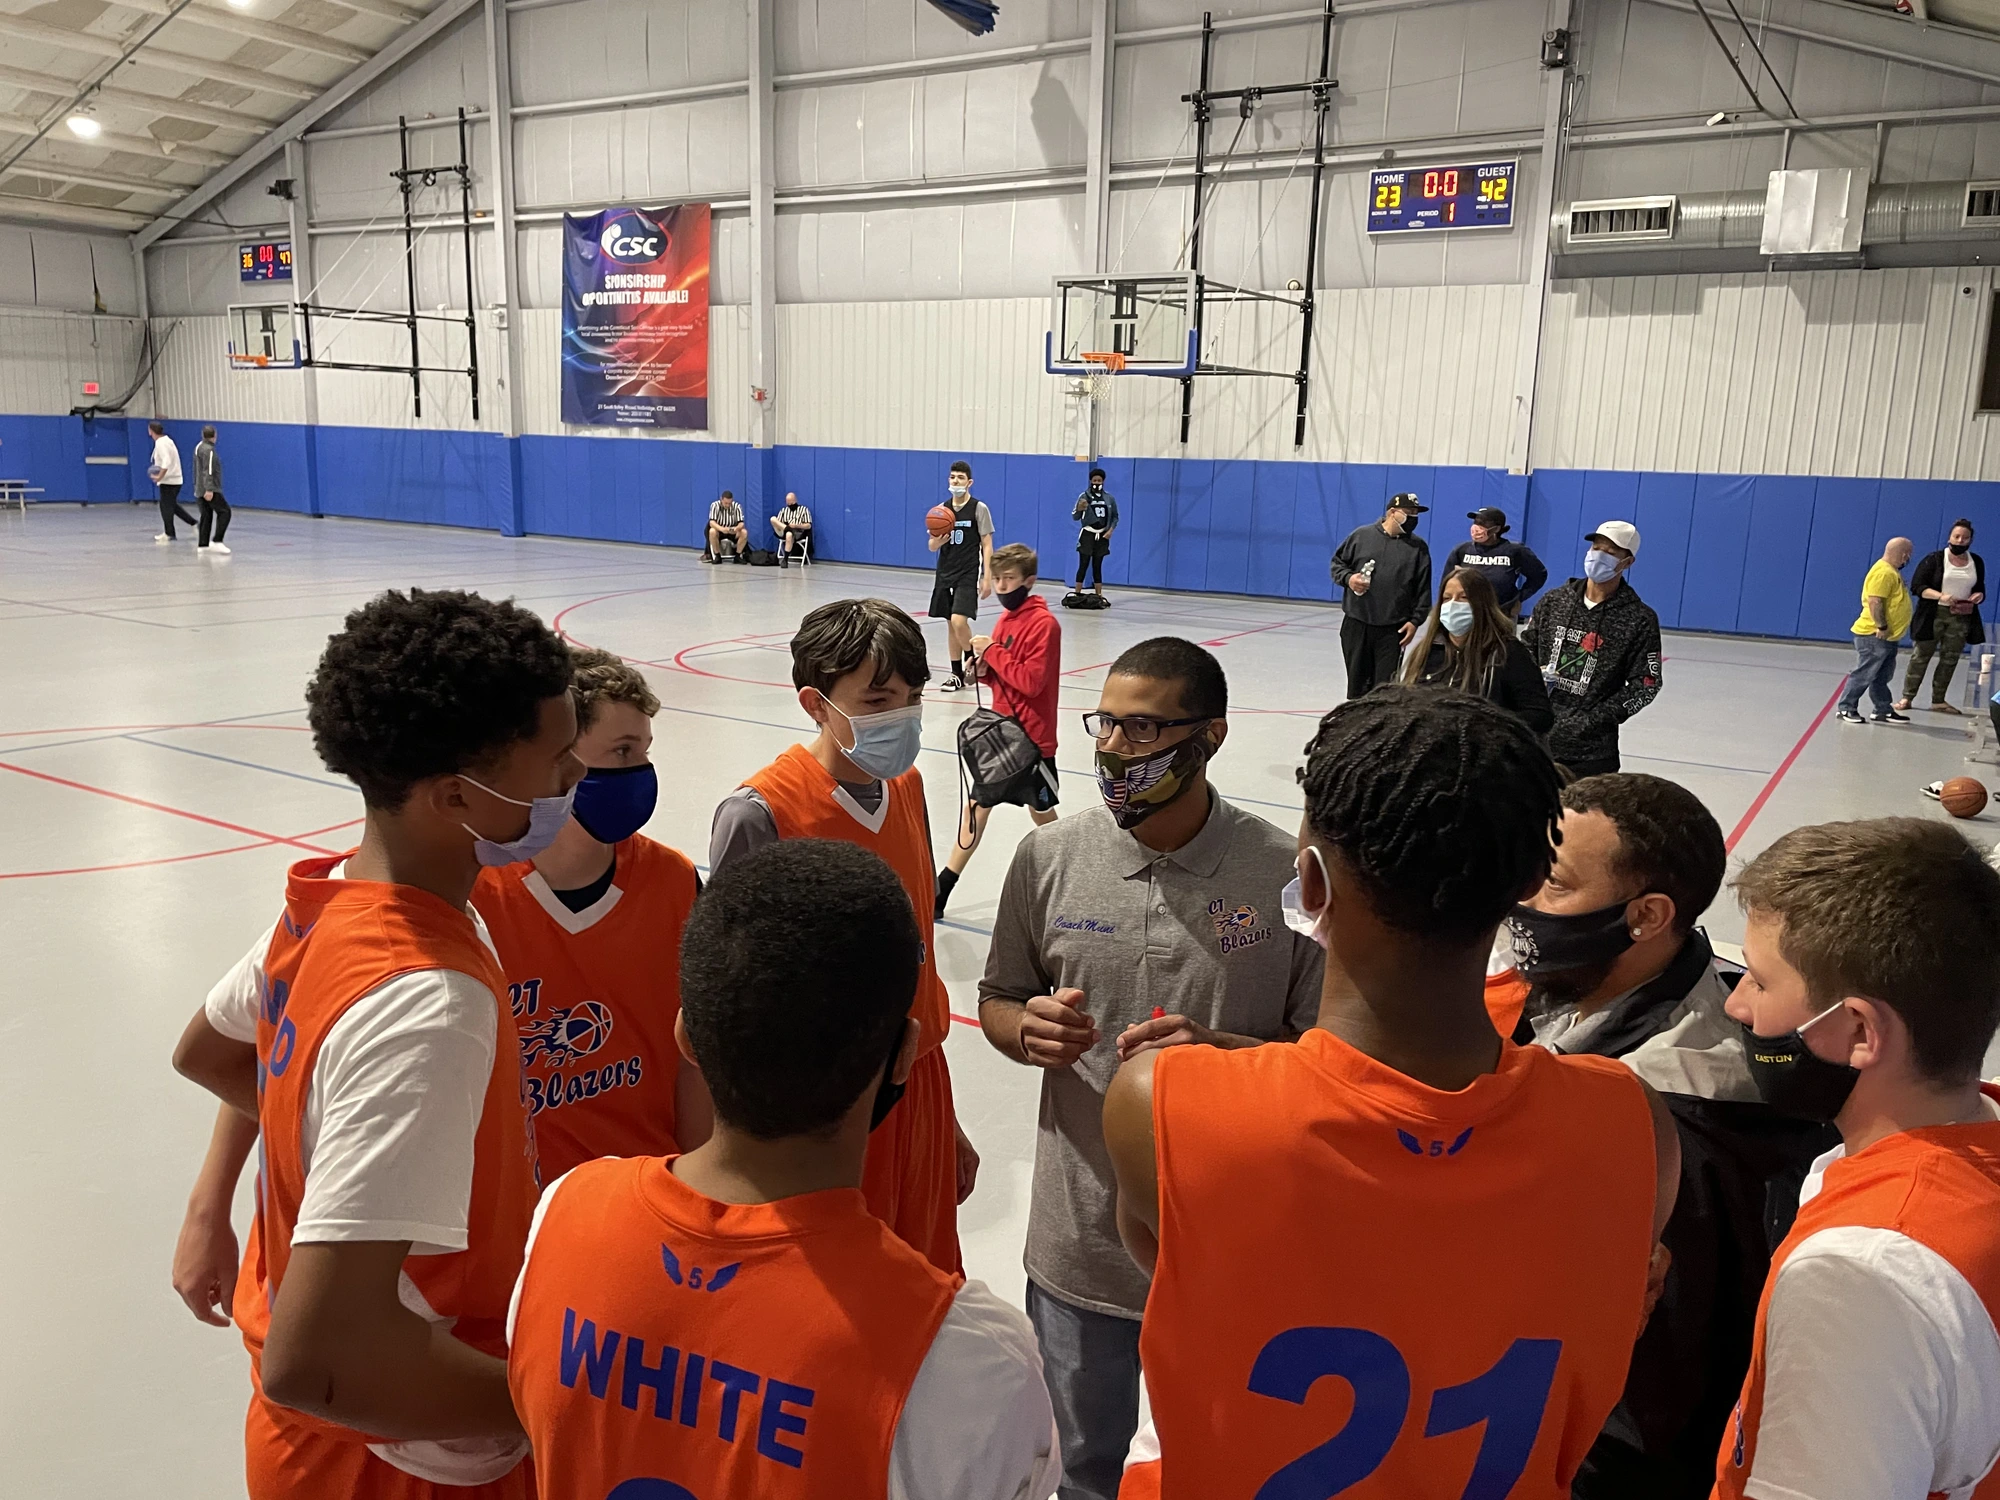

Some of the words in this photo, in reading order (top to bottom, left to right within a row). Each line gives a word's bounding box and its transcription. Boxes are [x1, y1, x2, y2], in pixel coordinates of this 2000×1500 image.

[1374, 174, 1405, 185] HOME
[1477, 166, 1513, 178] GUEST
[1375, 185, 1402, 208] 23
[1481, 178, 1508, 201] 42
[1448, 202, 1456, 222] 1
[612, 236, 659, 257] CSC
[1463, 553, 1511, 566] DREAMER
[1207, 898, 1225, 916] CT
[1054, 915, 1085, 931] Coach
[1219, 926, 1273, 955] Blazers
[1755, 1053, 1793, 1063] EASTON
[521, 1056, 643, 1117] Blazers
[1428, 1140, 1444, 1157] 5
[687, 1266, 703, 1290] 5
[559, 1306, 816, 1469] WHITE
[1246, 1325, 1563, 1500] 21
